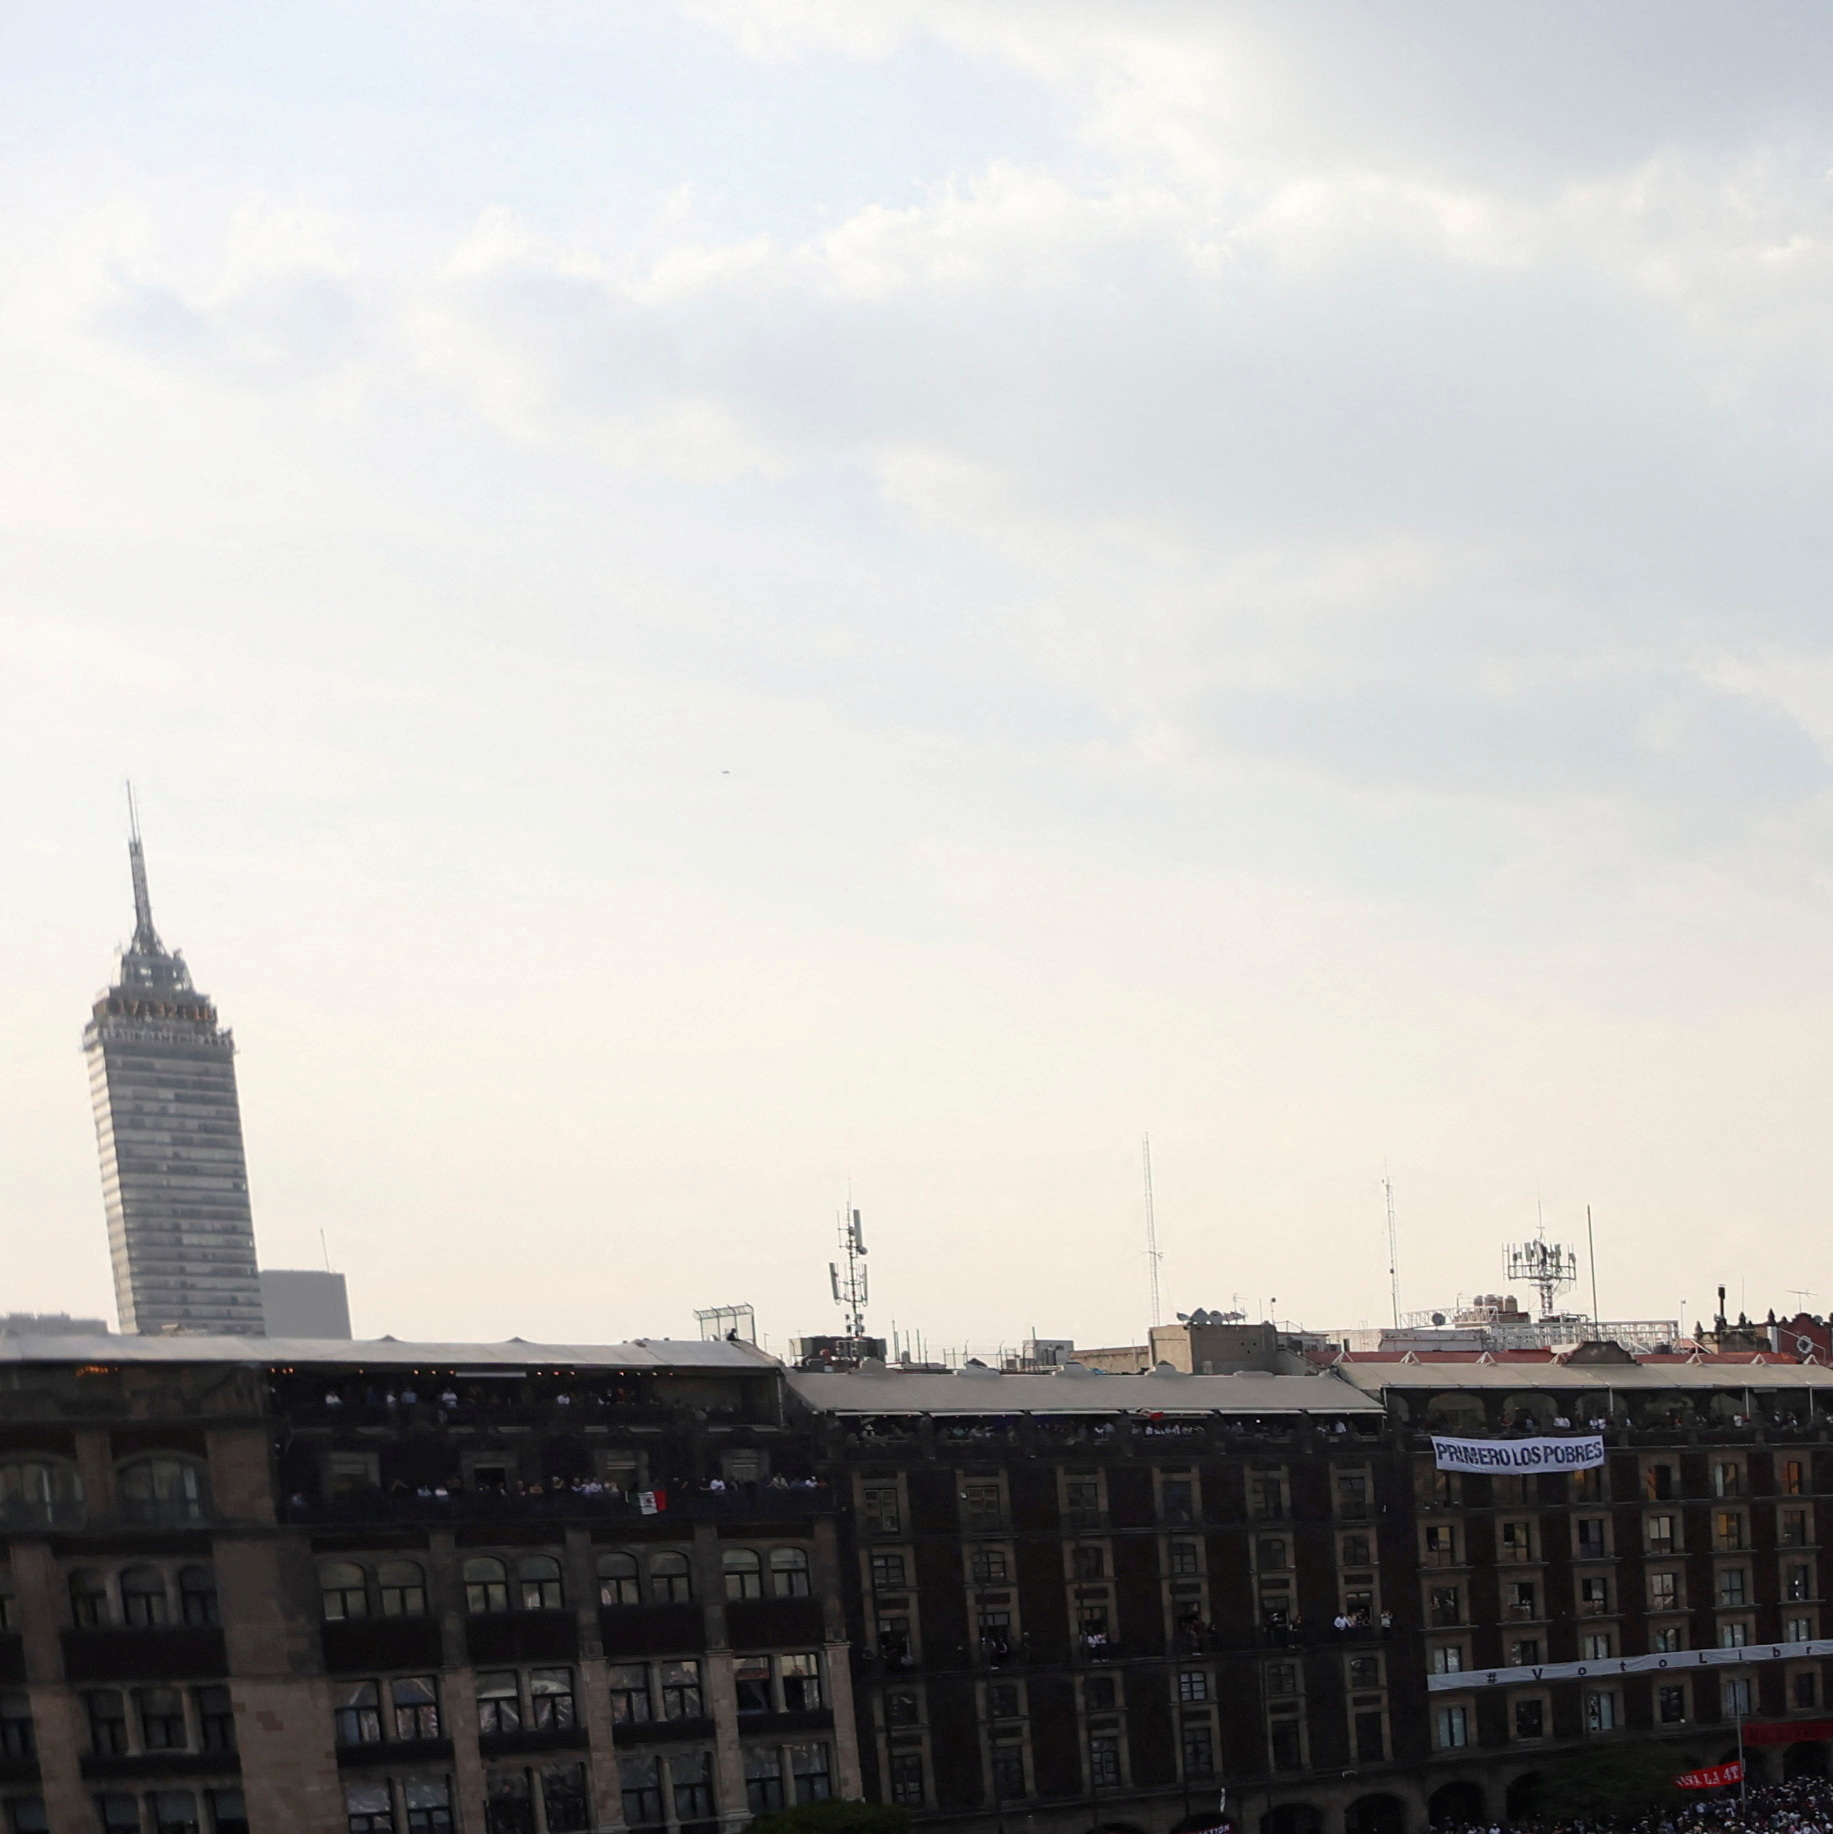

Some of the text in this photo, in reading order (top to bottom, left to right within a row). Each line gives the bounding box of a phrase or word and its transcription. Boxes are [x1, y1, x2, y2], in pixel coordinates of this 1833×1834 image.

[1436, 1441, 1602, 1466] PRIMERO LOS POBRES
